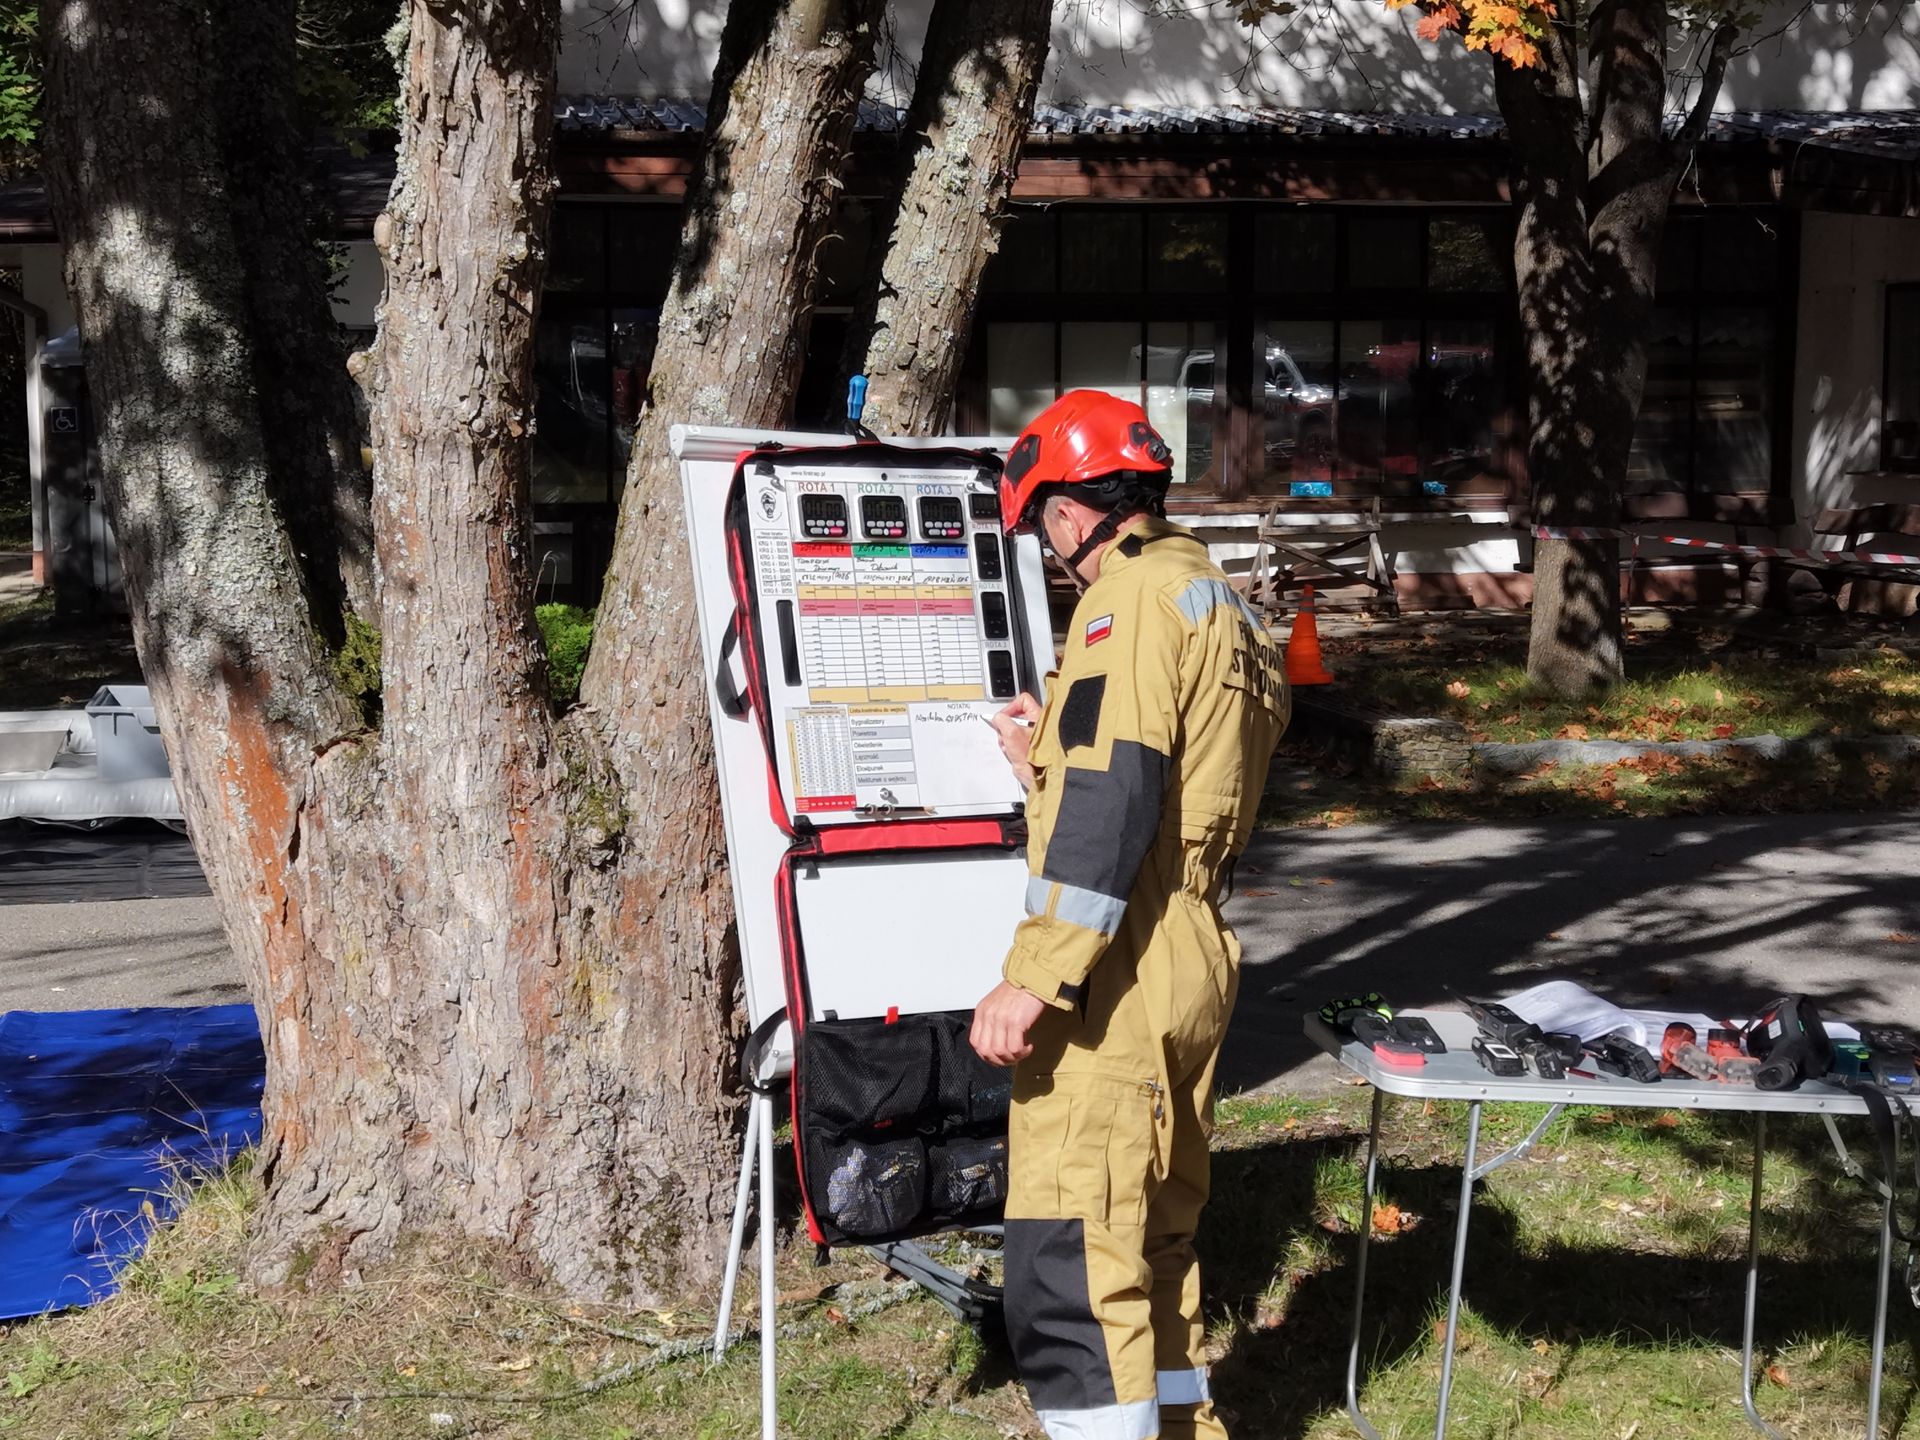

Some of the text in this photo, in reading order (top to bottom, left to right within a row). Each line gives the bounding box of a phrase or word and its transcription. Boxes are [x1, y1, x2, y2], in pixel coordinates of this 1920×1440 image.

[798, 482, 835, 493] ROTA 1
[857, 484, 895, 494] ROTA 2
[916, 485, 953, 495] ROTA 3
